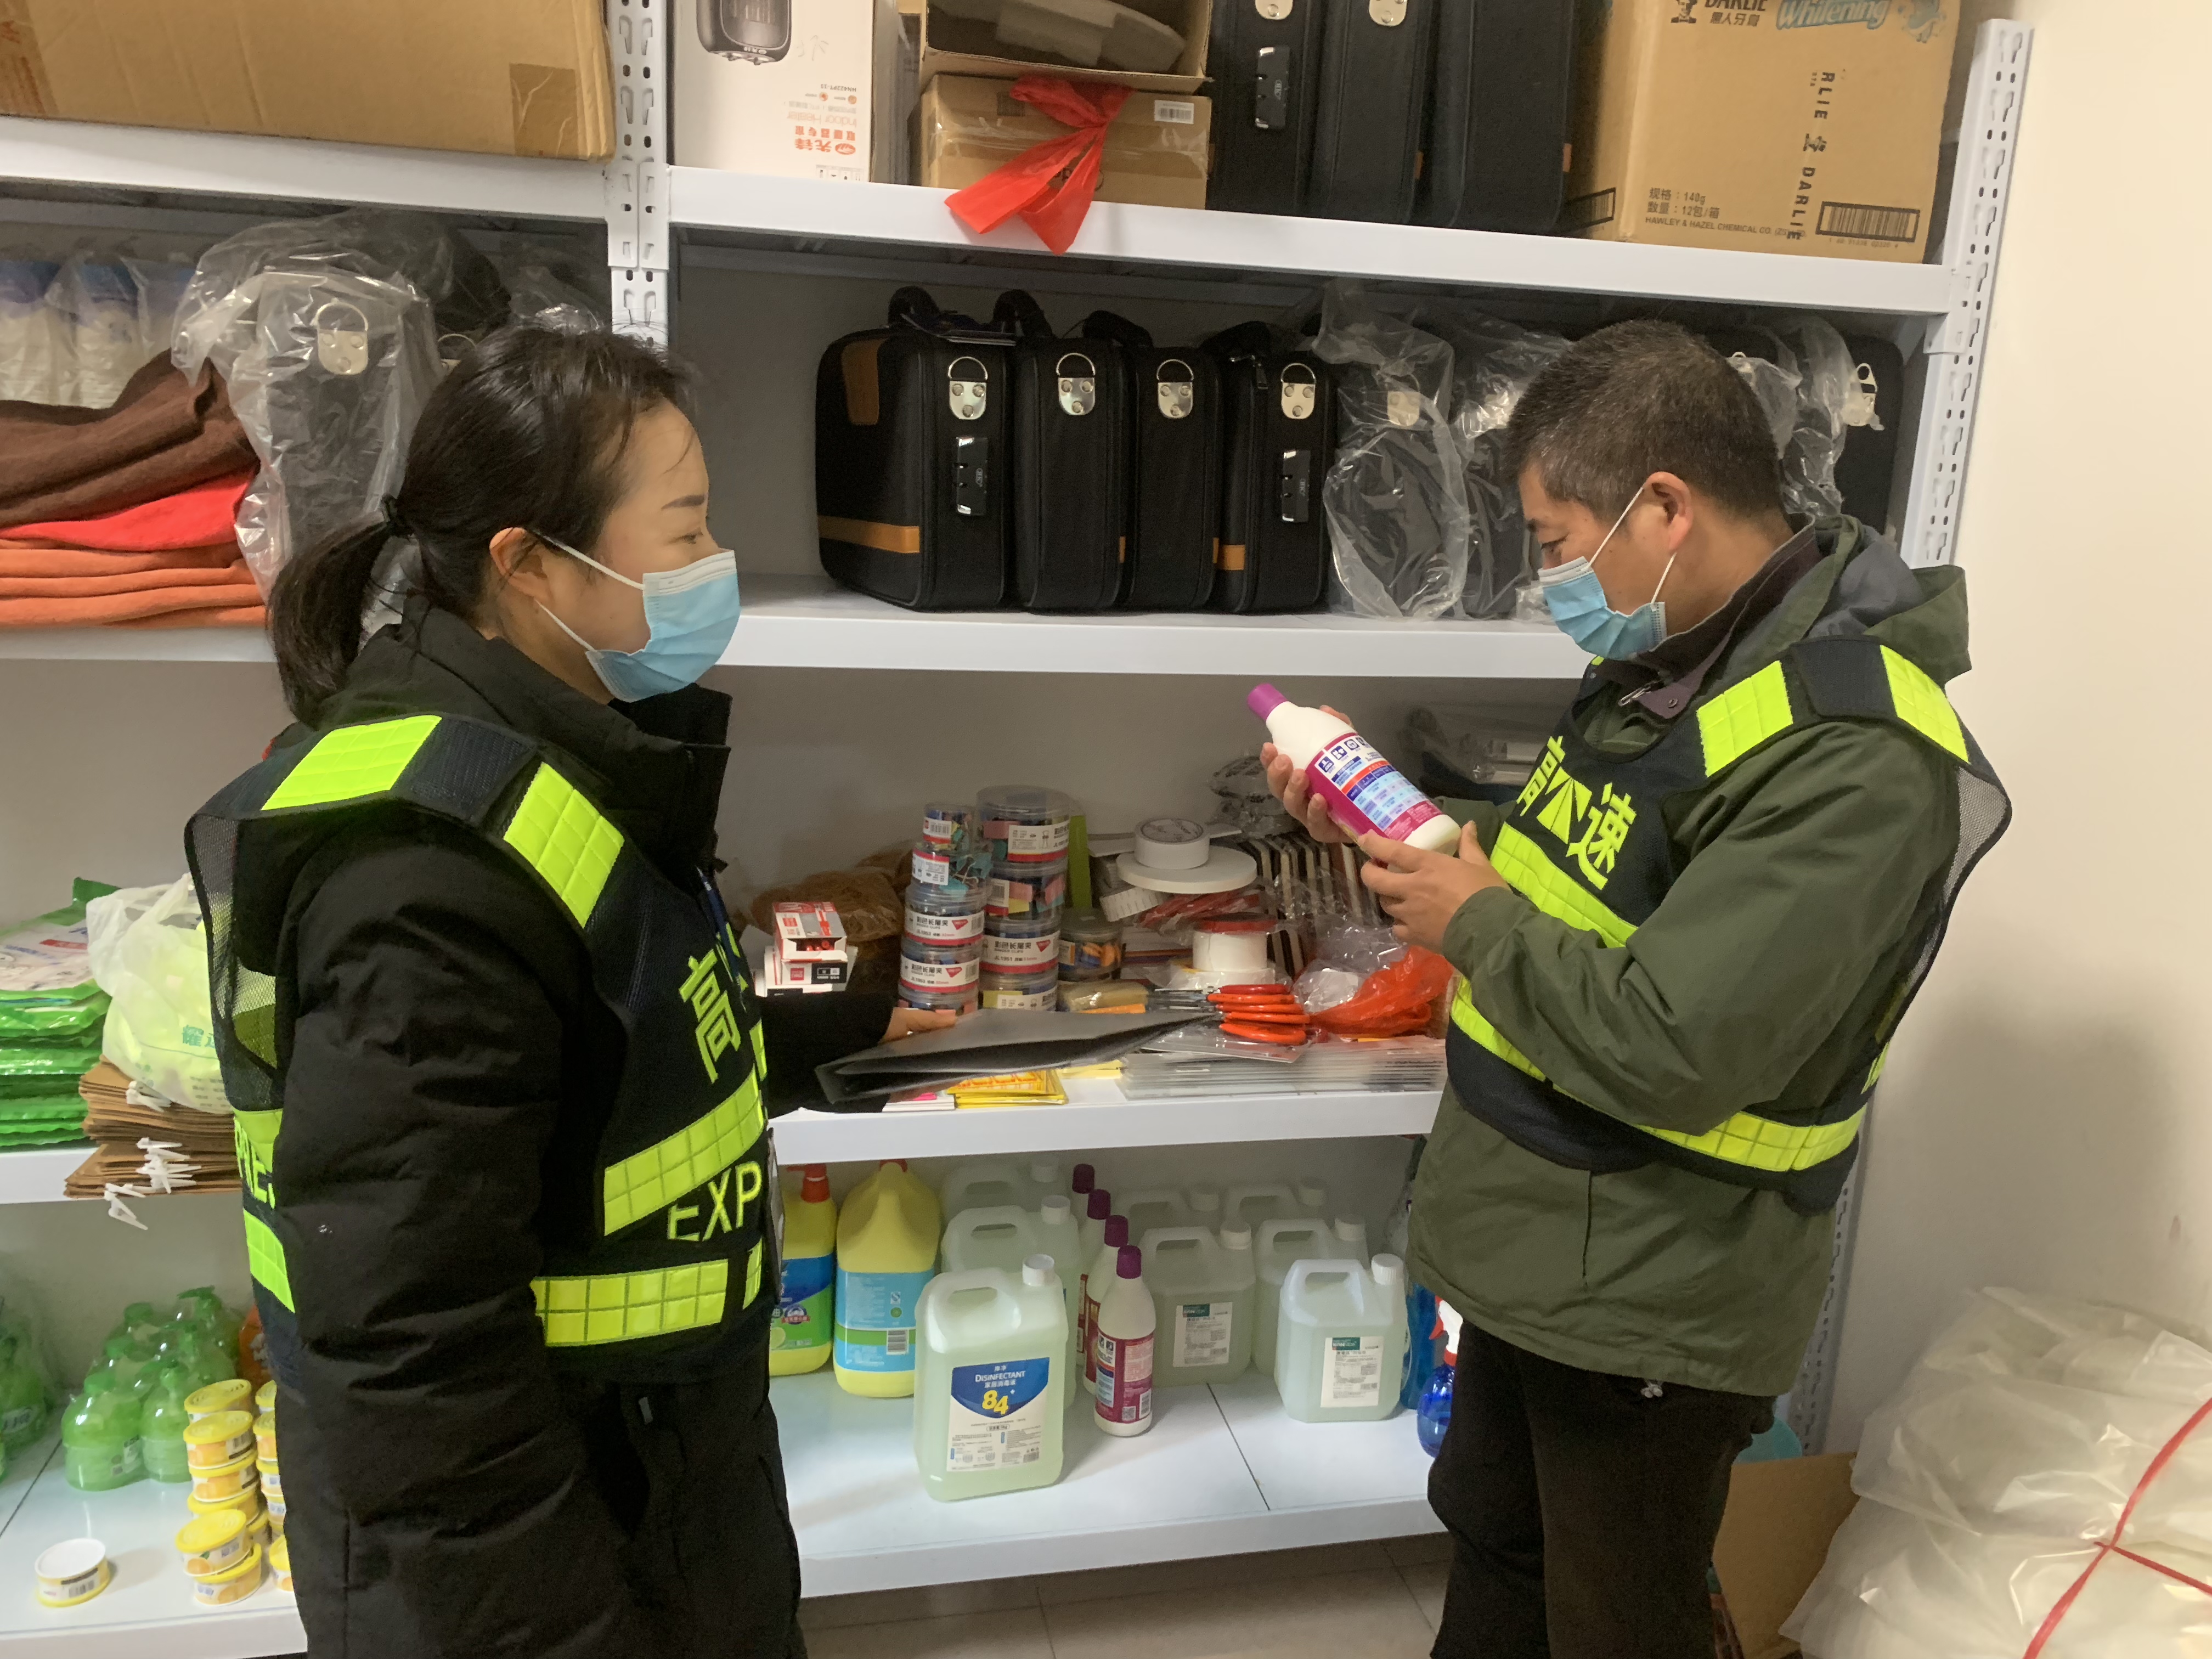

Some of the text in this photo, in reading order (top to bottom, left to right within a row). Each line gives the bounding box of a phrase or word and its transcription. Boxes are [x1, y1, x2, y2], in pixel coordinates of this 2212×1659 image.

[787, 111, 857, 128] Indoor Heater
[795, 138, 832, 153] 先锋
[1787, 167, 1816, 240] DARLIE
[1645, 217, 1680, 227] HAWLEY
[1690, 221, 1715, 230] HAZEL
[1717, 223, 1757, 234] CHEMICAL
[679, 950, 741, 1084] 高
[667, 1161, 763, 1242] EXP
[975, 1370, 1026, 1383] DISINFECTANT
[982, 1390, 1009, 1415] 84
